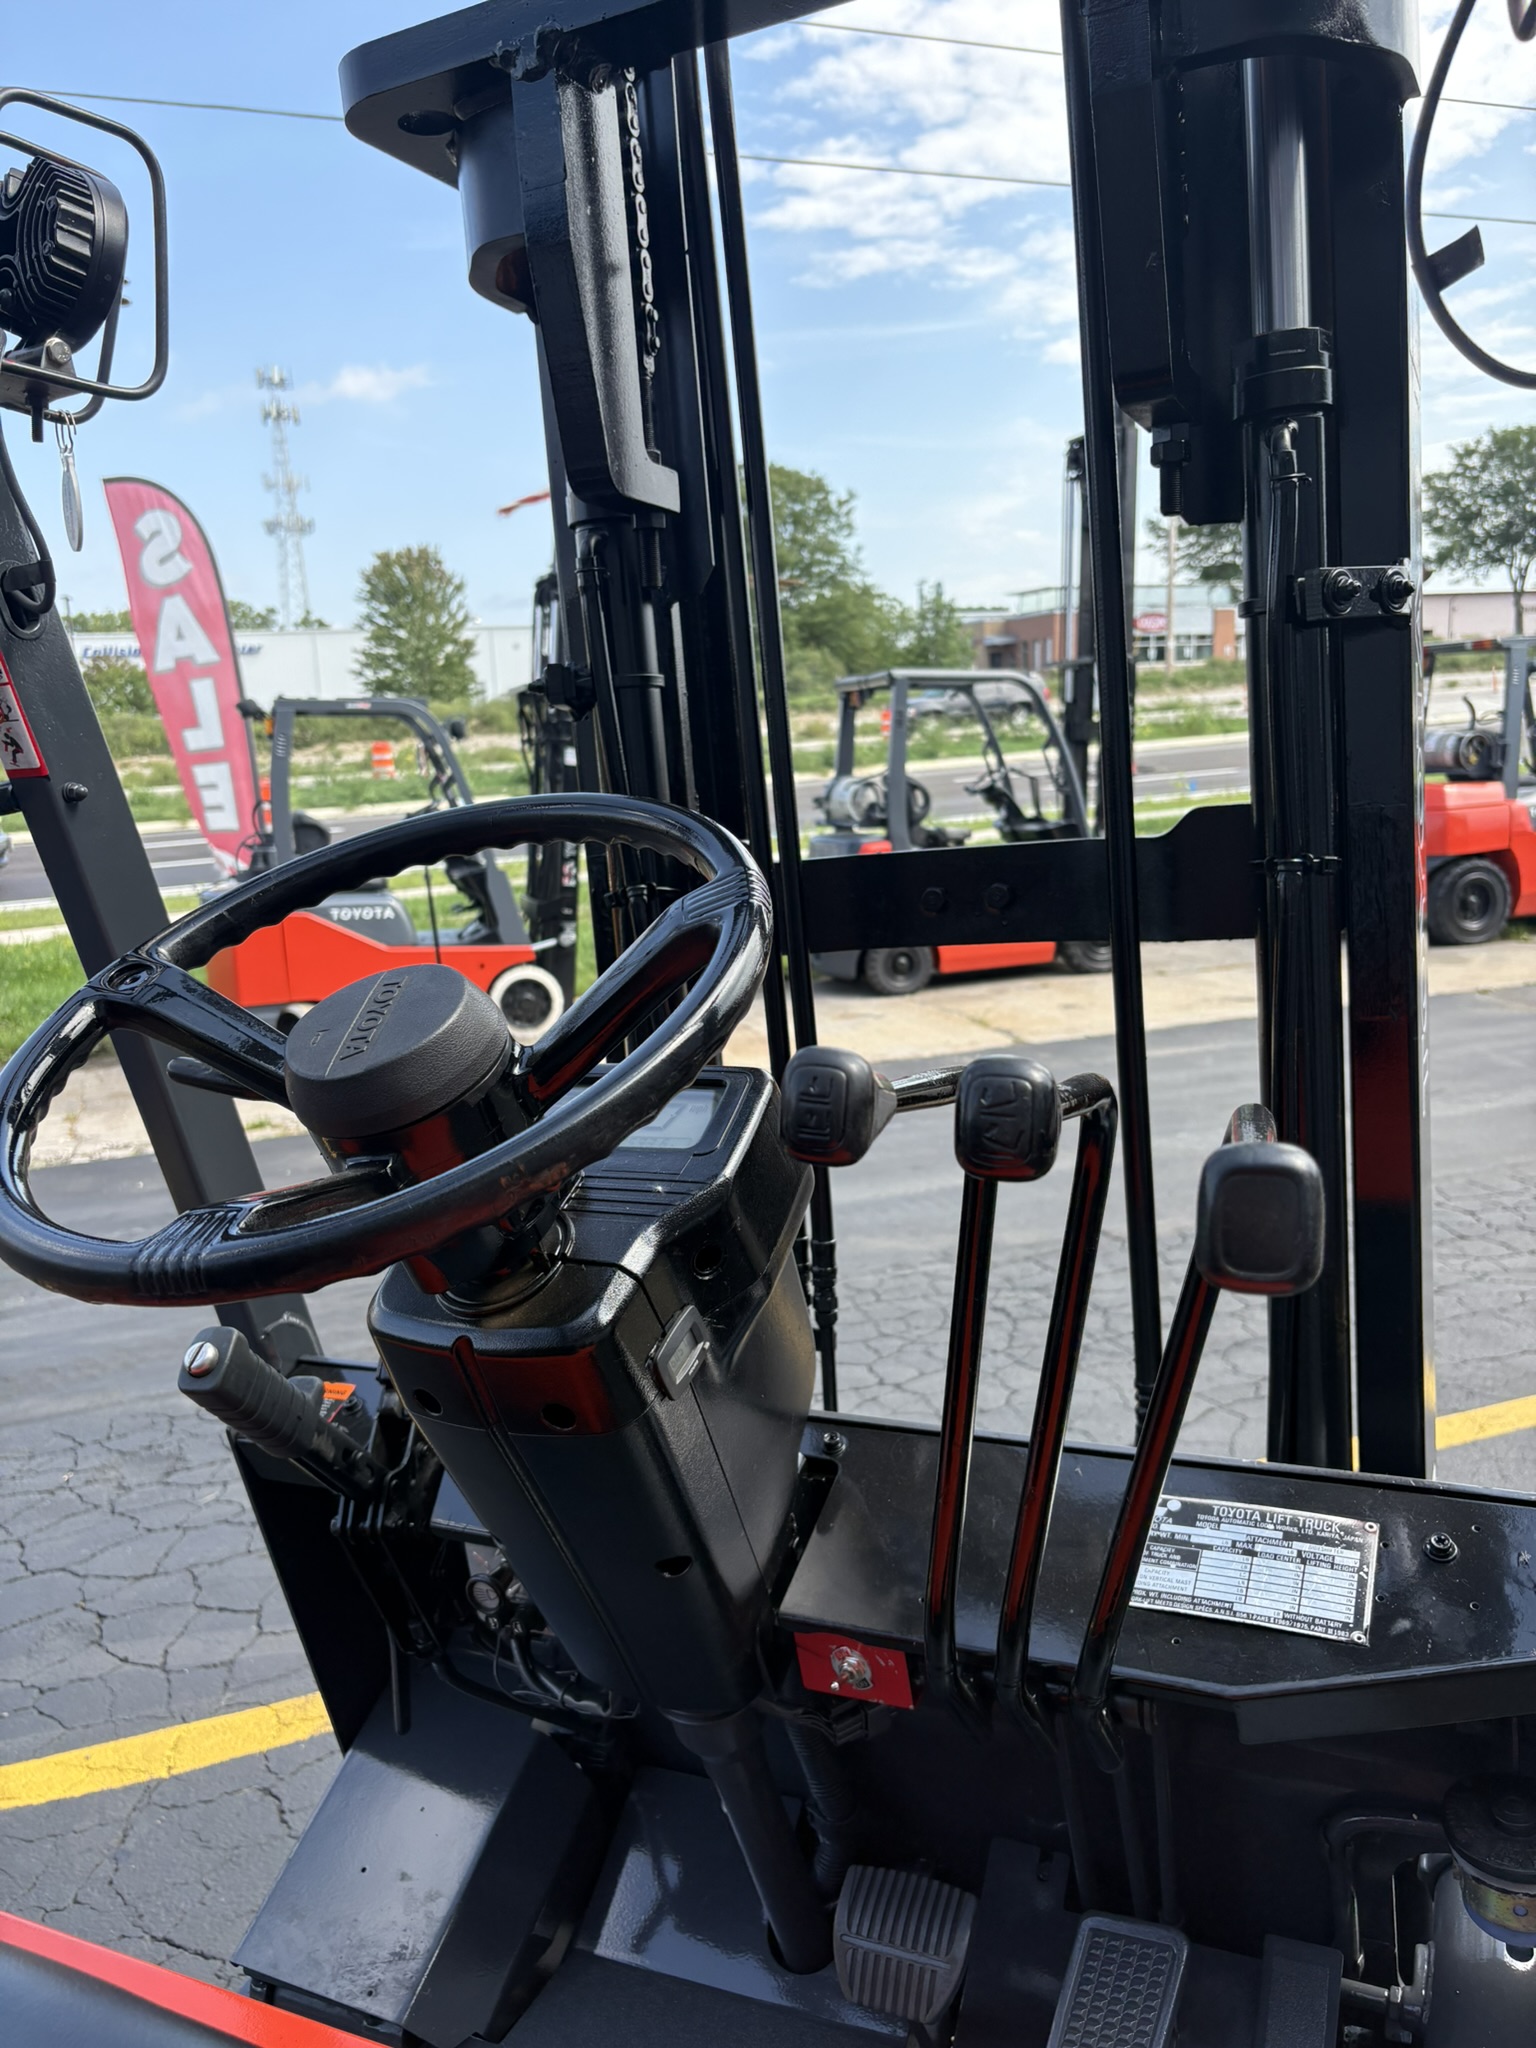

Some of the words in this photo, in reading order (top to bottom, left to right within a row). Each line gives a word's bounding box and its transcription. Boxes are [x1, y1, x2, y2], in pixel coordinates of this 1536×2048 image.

[83, 643, 142, 658] Collisio
[329, 906, 396, 921] TOYOTA
[339, 981, 402, 1061] TOYOTA
[1212, 1505, 1260, 1521] TOYOTA
[1266, 1512, 1292, 1525] LIFT
[1298, 1516, 1341, 1533] TRUCK
[1221, 1517, 1255, 1527] AUTOMATIC
[1195, 1521, 1219, 1530] MODEL
[1245, 1535, 1293, 1548] ATTACHMENT
[1213, 1545, 1244, 1554] CAPACITY
[1257, 1551, 1275, 1559] LOAD
[1276, 1554, 1301, 1563] CENTER
[1301, 1551, 1334, 1562] VOLTAGE
[1306, 1560, 1331, 1569] LIFTING
[1334, 1563, 1359, 1573] HEIGHT
[1149, 1575, 1174, 1585] VERTICAL
[1176, 1578, 1191, 1586] MAST
[1152, 1581, 1188, 1592] ATTACHMENT
[1160, 1593, 1192, 1603] INCLUDING
[1193, 1596, 1234, 1608] ATTACHMENT
[1173, 1600, 1193, 1609] DESIGN
[1283, 1612, 1313, 1623] WITHOUT
[1314, 1618, 1343, 1628] BATTERY
